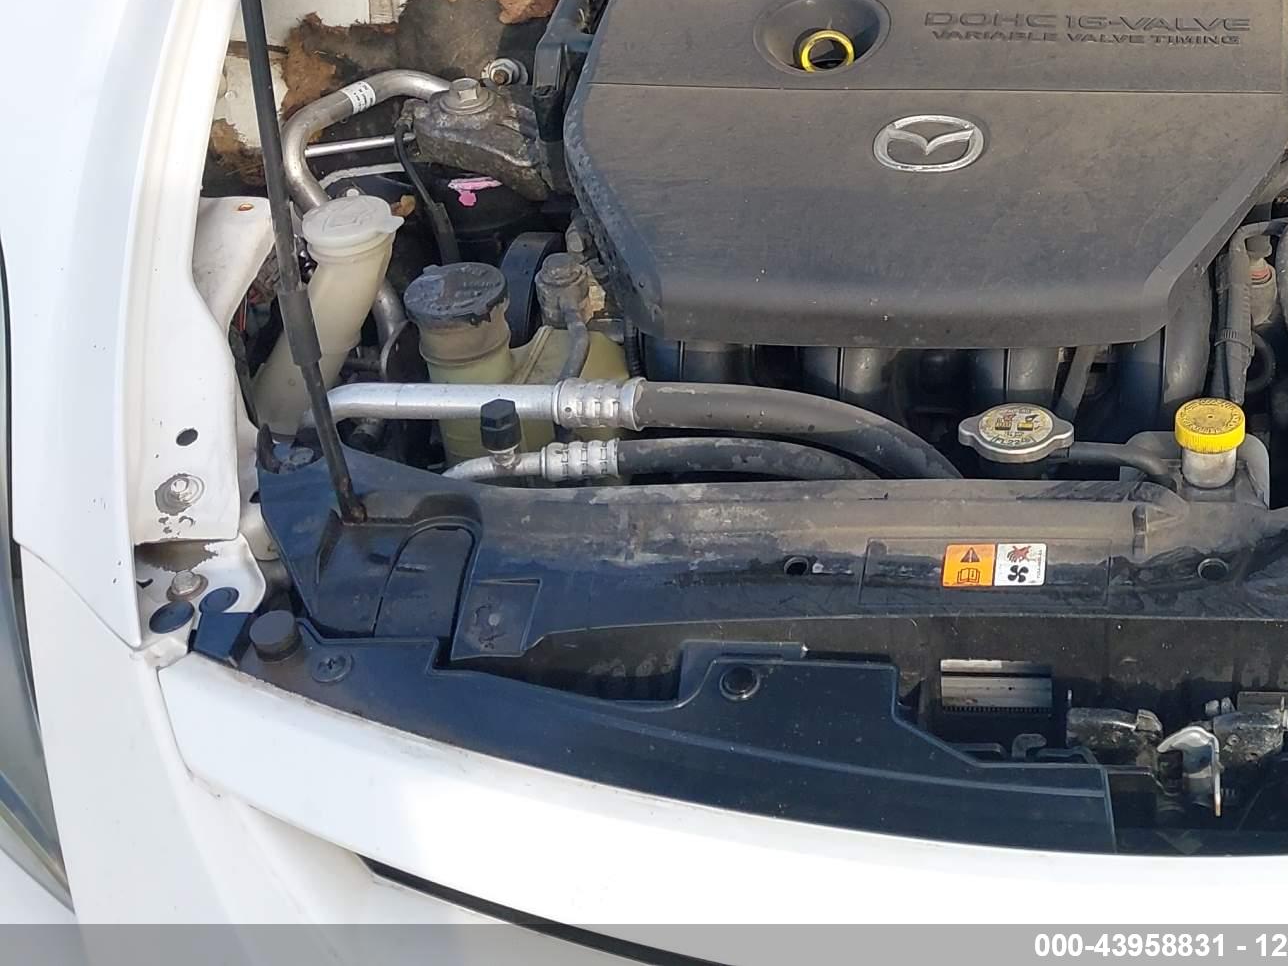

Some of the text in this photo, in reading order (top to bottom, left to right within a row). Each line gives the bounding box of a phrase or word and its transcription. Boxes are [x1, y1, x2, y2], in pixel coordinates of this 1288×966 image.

[924, 11, 1251, 32] DOHC 16-VALVE
[932, 30, 1241, 46] VARIABLE VALVE TIMING
